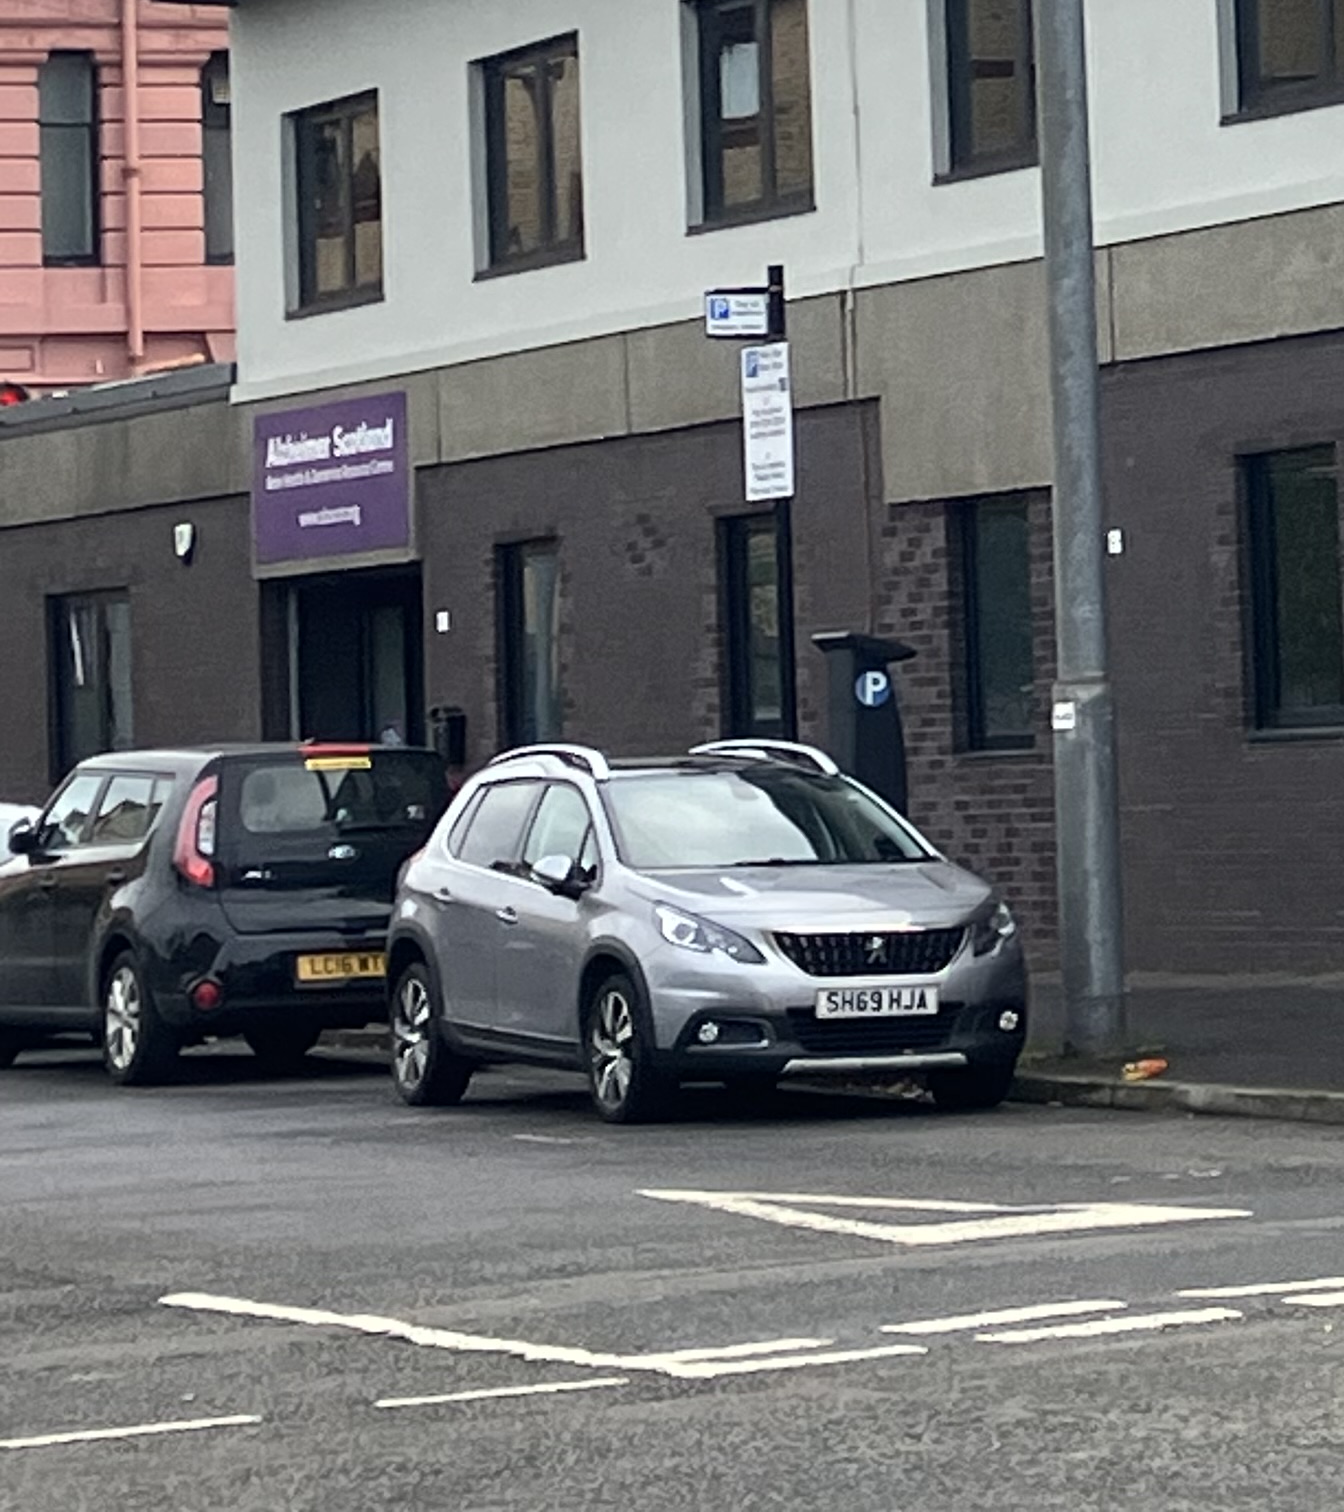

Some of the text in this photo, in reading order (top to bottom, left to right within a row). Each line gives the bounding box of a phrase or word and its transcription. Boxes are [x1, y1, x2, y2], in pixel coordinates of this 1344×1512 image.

[865, 670, 888, 706] P
[826, 988, 929, 1013] SH69 HJA
